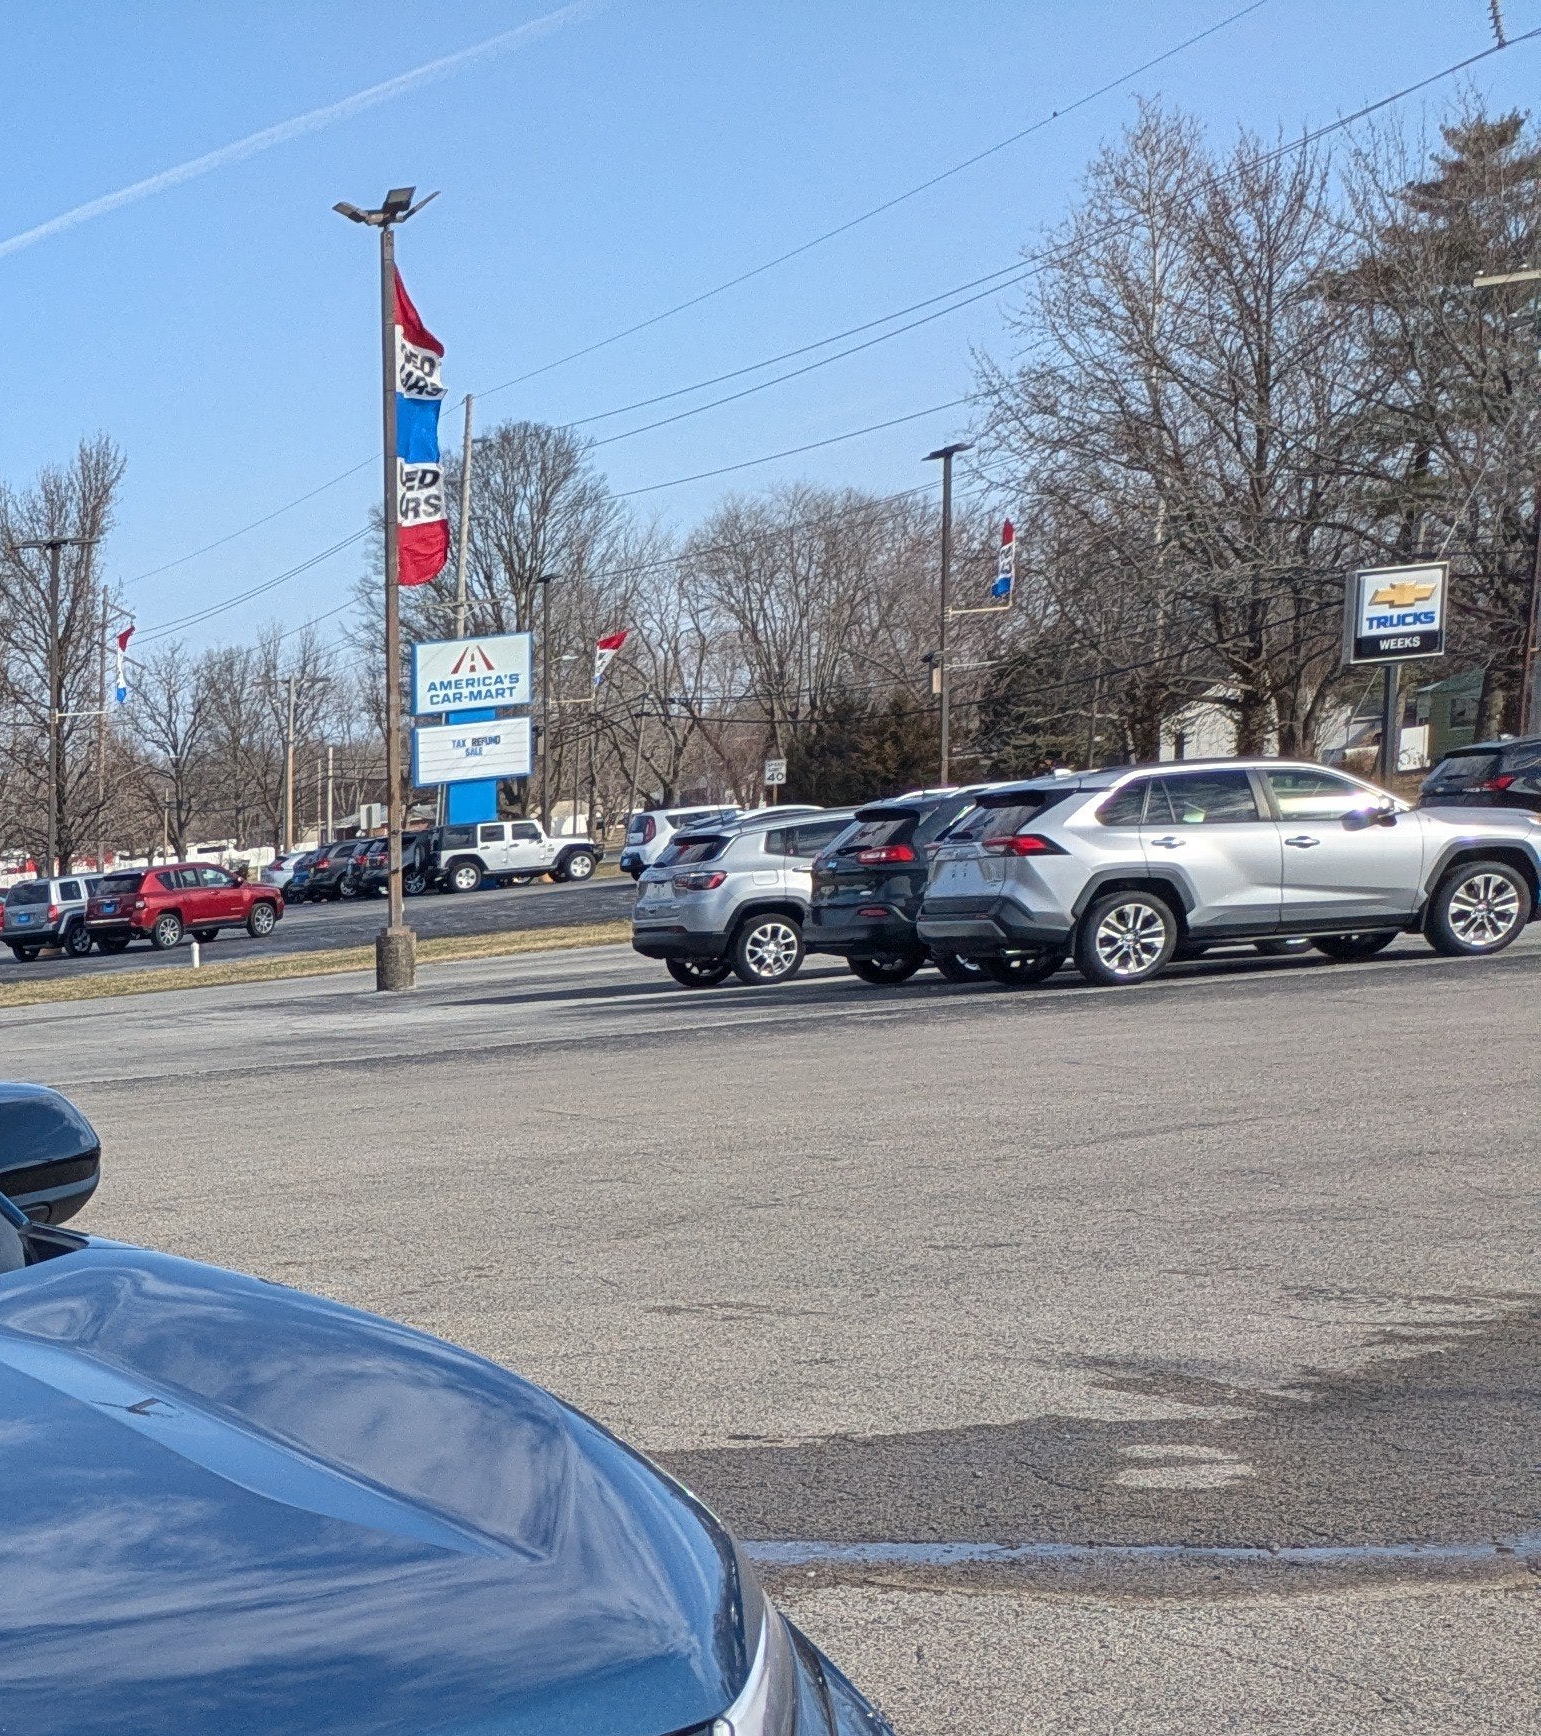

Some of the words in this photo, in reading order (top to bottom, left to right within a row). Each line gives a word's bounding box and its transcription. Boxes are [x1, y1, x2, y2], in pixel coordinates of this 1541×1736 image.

[1366, 611, 1435, 630] TRUCKS
[1379, 636, 1421, 650] WEEKS
[426, 674, 521, 693] AMERICA'S
[429, 686, 517, 706] CAR-MART
[452, 739, 466, 748] TAX
[471, 735, 501, 746] REFUND
[465, 747, 483, 756] SALE
[767, 772, 784, 781] 40
